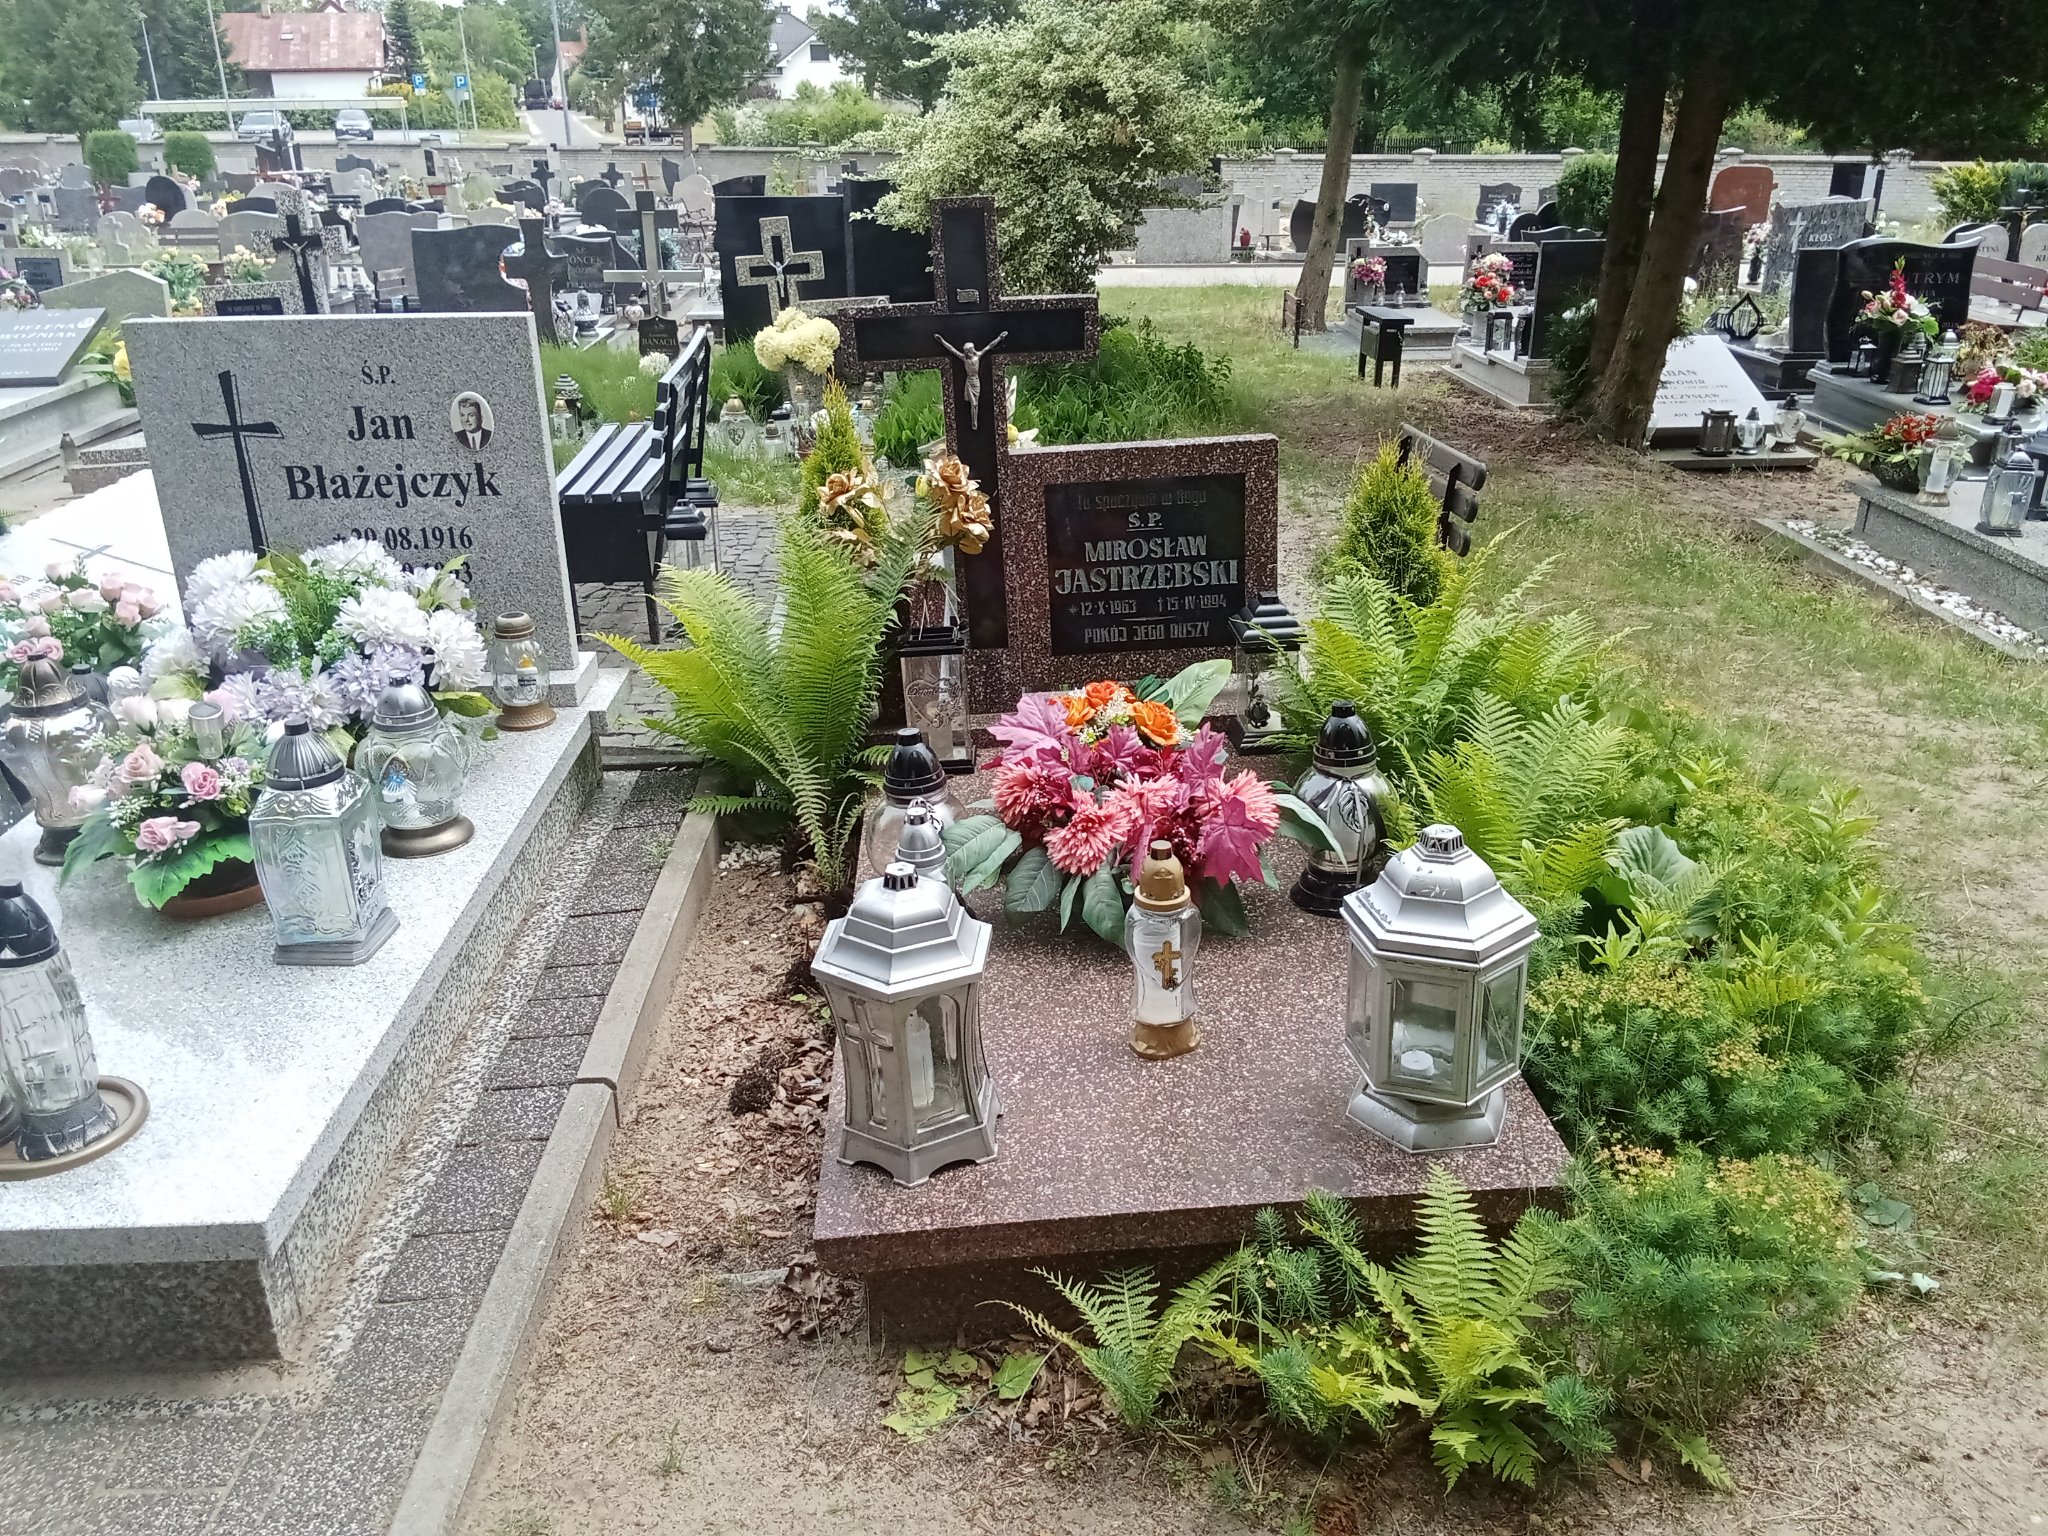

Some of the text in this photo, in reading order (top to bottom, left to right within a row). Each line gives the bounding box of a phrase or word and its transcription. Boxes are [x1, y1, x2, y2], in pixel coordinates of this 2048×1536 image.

[414, 75, 423, 86] P
[456, 76, 465, 87] P
[361, 359, 396, 385] Ś.P.
[347, 405, 416, 441] Jan
[283, 461, 503, 508] Błażejczyk
[1084, 534, 1208, 562] MIROSŁAW
[1054, 559, 1239, 595] JASTRZĘBSKI
[1084, 620, 1210, 644] POKÓJ JEGO DUSZY
